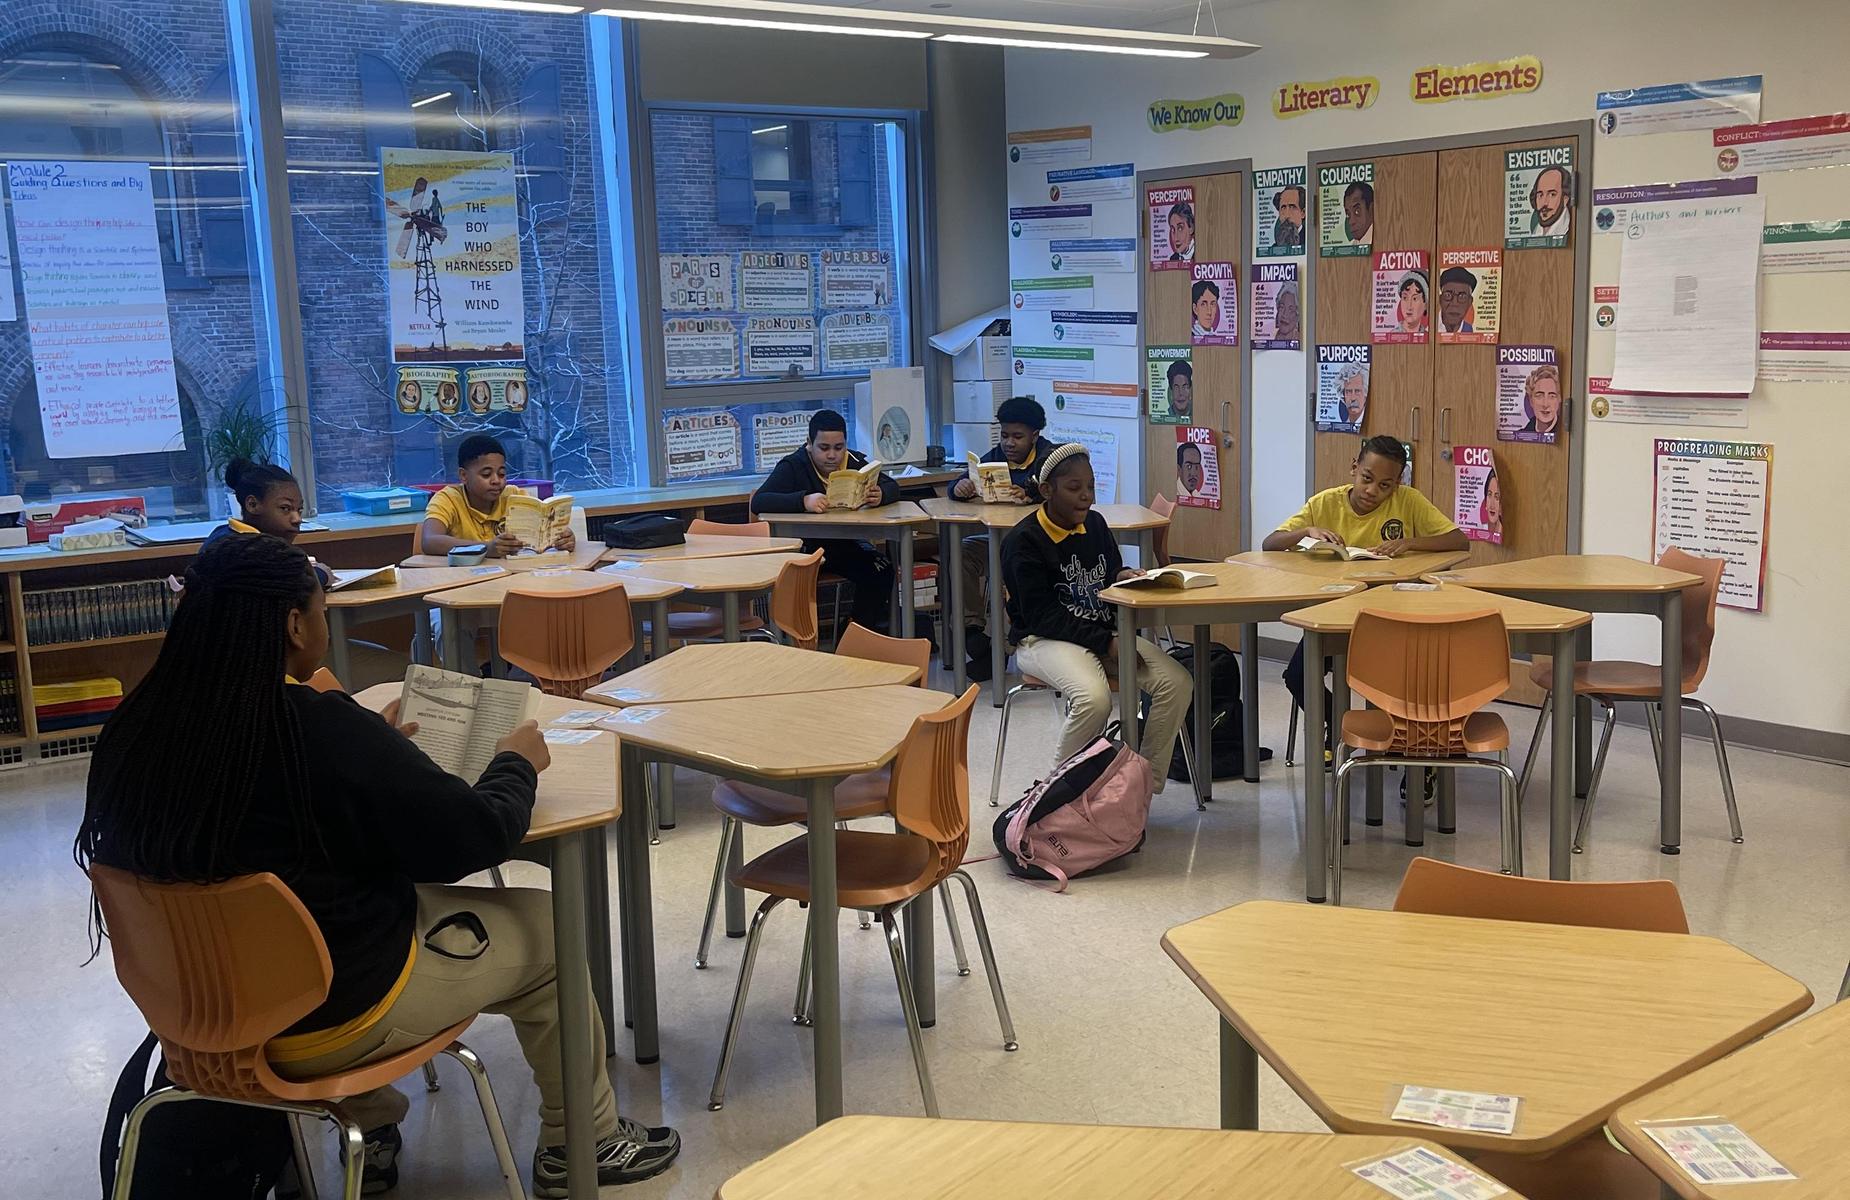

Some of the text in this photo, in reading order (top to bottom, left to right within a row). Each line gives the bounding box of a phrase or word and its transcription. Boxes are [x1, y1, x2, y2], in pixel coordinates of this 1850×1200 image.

[1151, 64, 1538, 126] We Know Our Literary Elements
[1508, 147, 1570, 169] EXISTENCE
[54, 164, 67, 177] 2
[1255, 168, 1303, 188] EMPATHY
[1320, 164, 1372, 185] COURAGE
[11, 176, 143, 191] Guiding Questions and Big
[13, 190, 38, 200] Ideas
[1149, 188, 1193, 204] PERCEPTION
[465, 202, 487, 213] THE
[1679, 209, 1697, 218] and
[466, 222, 489, 233] BOY
[464, 241, 492, 252] WHO
[744, 254, 808, 269] ADJECTIVES
[834, 250, 880, 264] VERBS
[1379, 251, 1421, 270] ACTION
[1442, 250, 1499, 265] PERSPECTIVE
[445, 260, 514, 272] HARNESSED
[671, 260, 720, 278] PARTS
[1193, 263, 1233, 279] GROWTH
[1260, 264, 1296, 281] IMPACT
[471, 280, 492, 291] THE
[670, 287, 724, 306] SPEECH
[465, 299, 500, 310] WIND
[677, 319, 720, 333] NOUNS
[751, 318, 812, 330] PRONOUNS
[839, 312, 877, 326] ADVERBS
[408, 323, 431, 331] NETFLIX
[1148, 348, 1191, 358] EMPOWERMENT
[1319, 345, 1368, 362] PURPOSE
[1500, 348, 1555, 363] POSSIBILITY
[406, 370, 452, 379] BIOGRAPHY
[471, 371, 524, 380] AUTOBIOGRAPHY
[672, 415, 729, 431] ARTICLES
[755, 414, 812, 427] PREPOSITIO
[1186, 427, 1210, 443] HOPE
[1464, 447, 1492, 465] CHO
[1657, 441, 1769, 458] PROOFREADING MARKS
